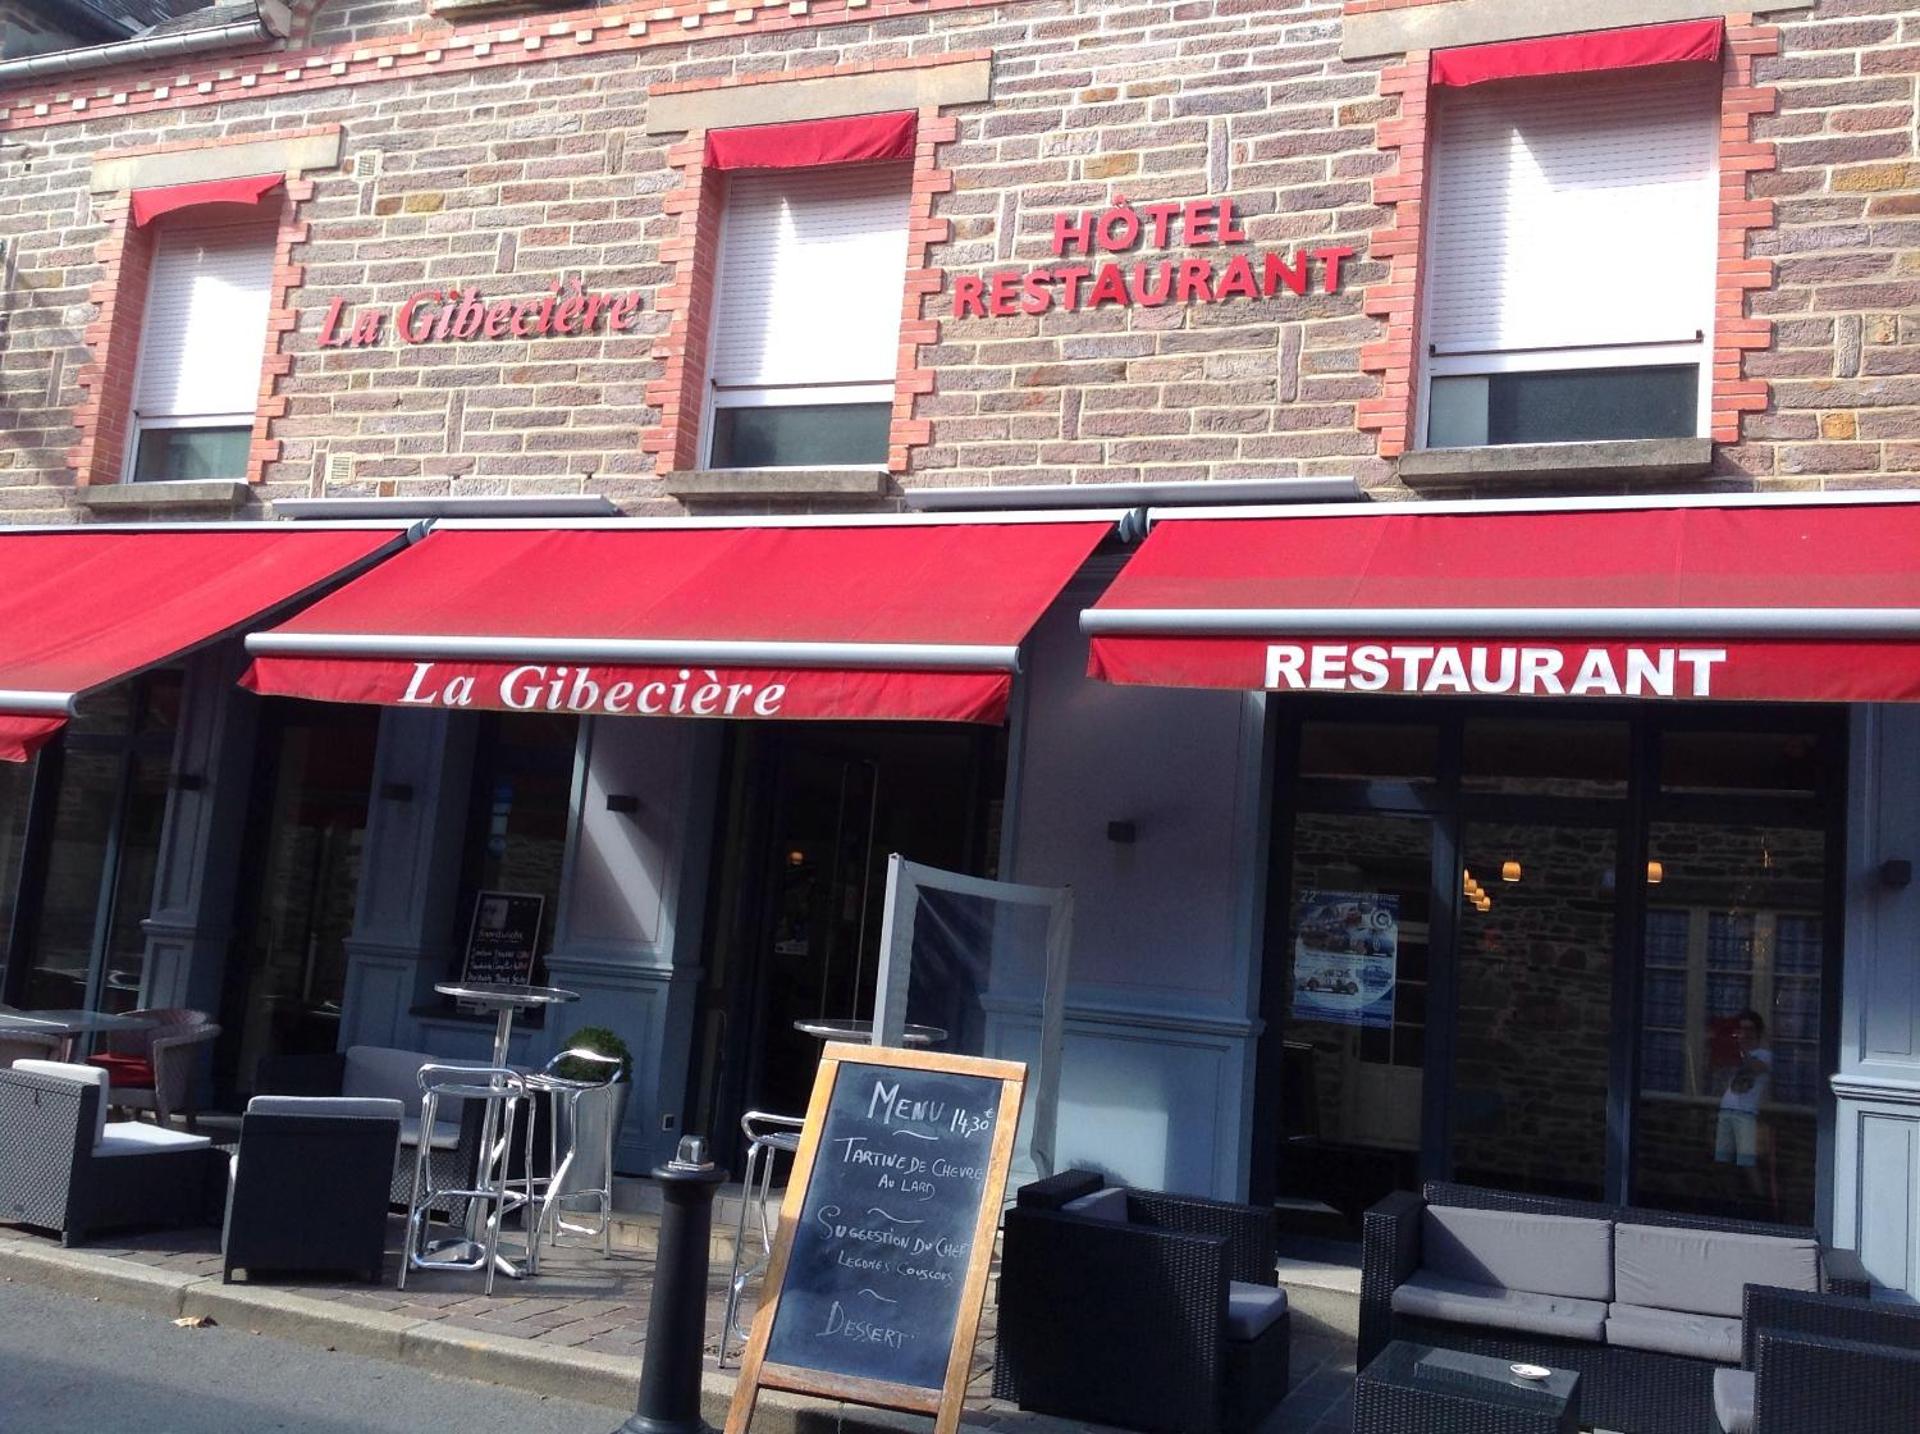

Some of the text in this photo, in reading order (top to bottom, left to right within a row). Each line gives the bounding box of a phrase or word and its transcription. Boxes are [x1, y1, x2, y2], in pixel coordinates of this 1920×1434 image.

[953, 246, 1353, 318] RESTAURANT
[317, 276, 642, 347] La Gibecière
[397, 662, 786, 716] La Gibecière
[1264, 645, 1726, 696] RESTAURANT
[867, 1081, 944, 1124] MENU
[834, 1137, 906, 1169] TARTINE
[904, 1157, 926, 1174] DE
[816, 1301, 909, 1349] DESSERT
